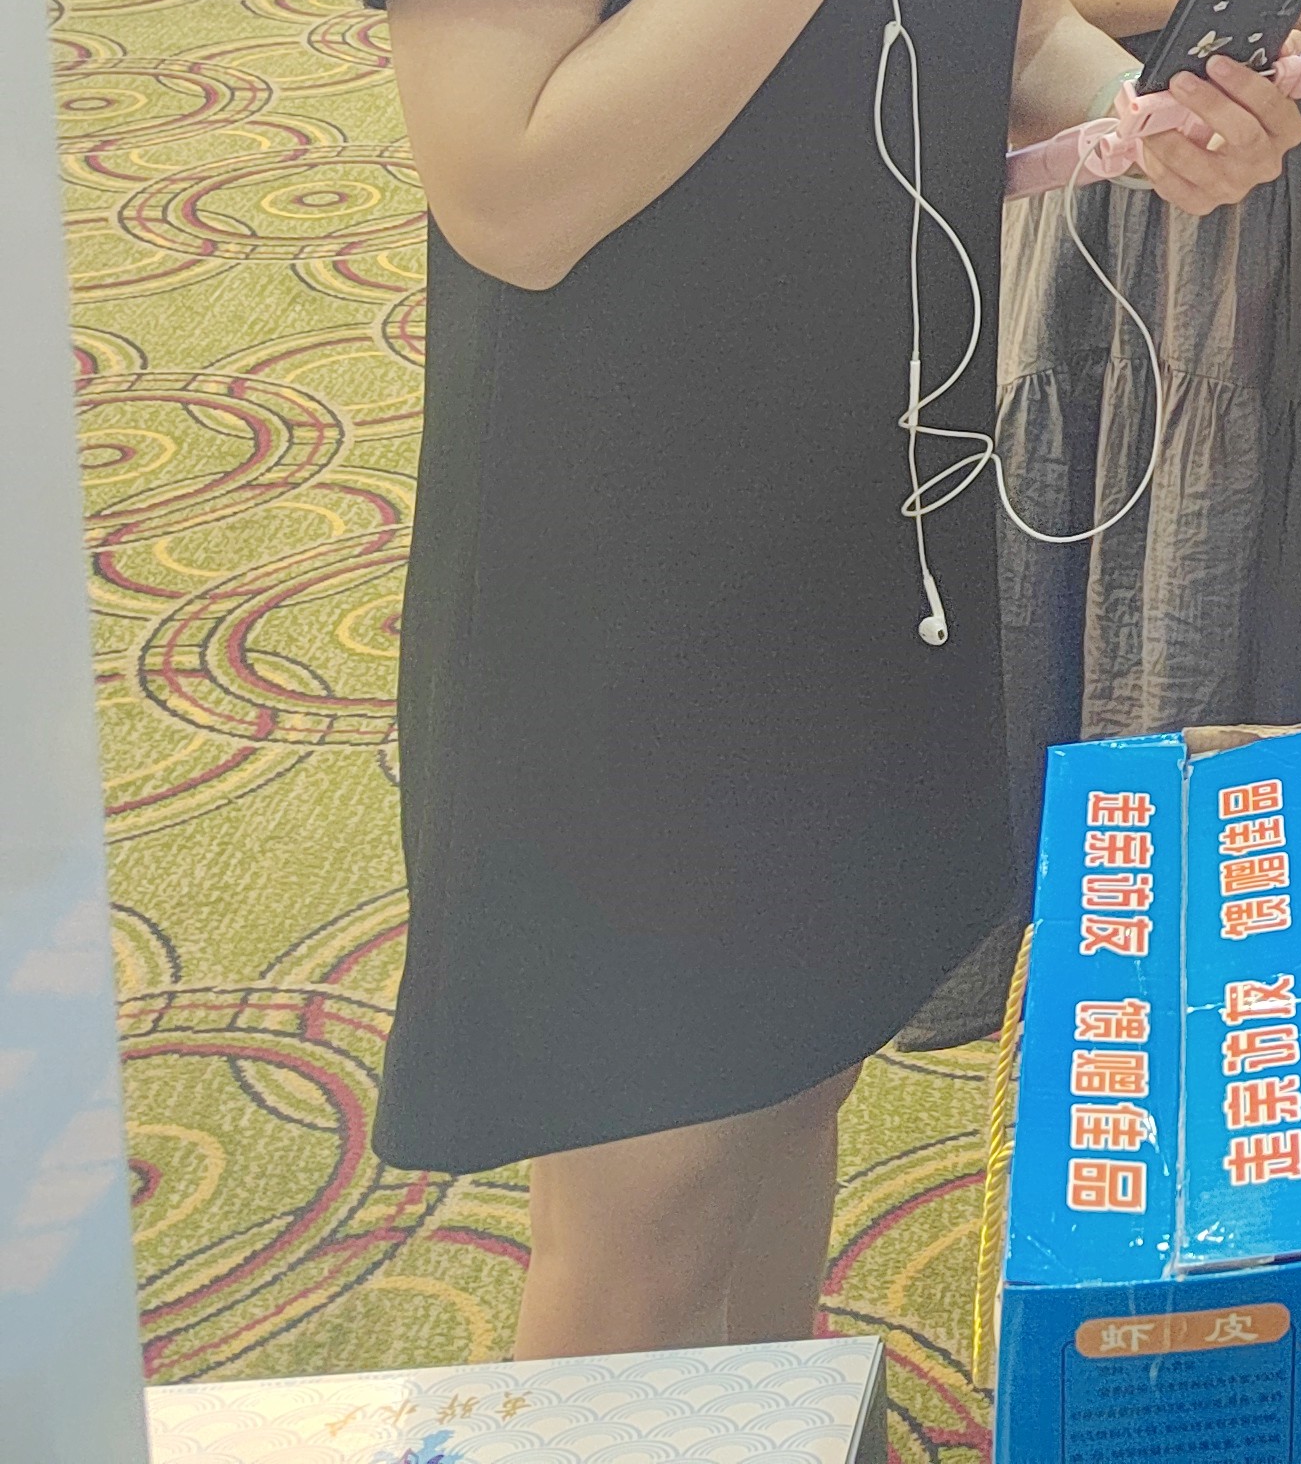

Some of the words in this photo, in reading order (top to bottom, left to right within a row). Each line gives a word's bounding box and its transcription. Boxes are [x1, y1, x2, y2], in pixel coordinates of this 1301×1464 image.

[1079, 790, 1156, 956] 走亲访友
[1217, 777, 1293, 940] 馈赠佳品
[1067, 999, 1152, 1215] 馈赠佳品
[325, 1390, 533, 1437] 黄骅水产
[1100, 1312, 1259, 1353] 虾皮
